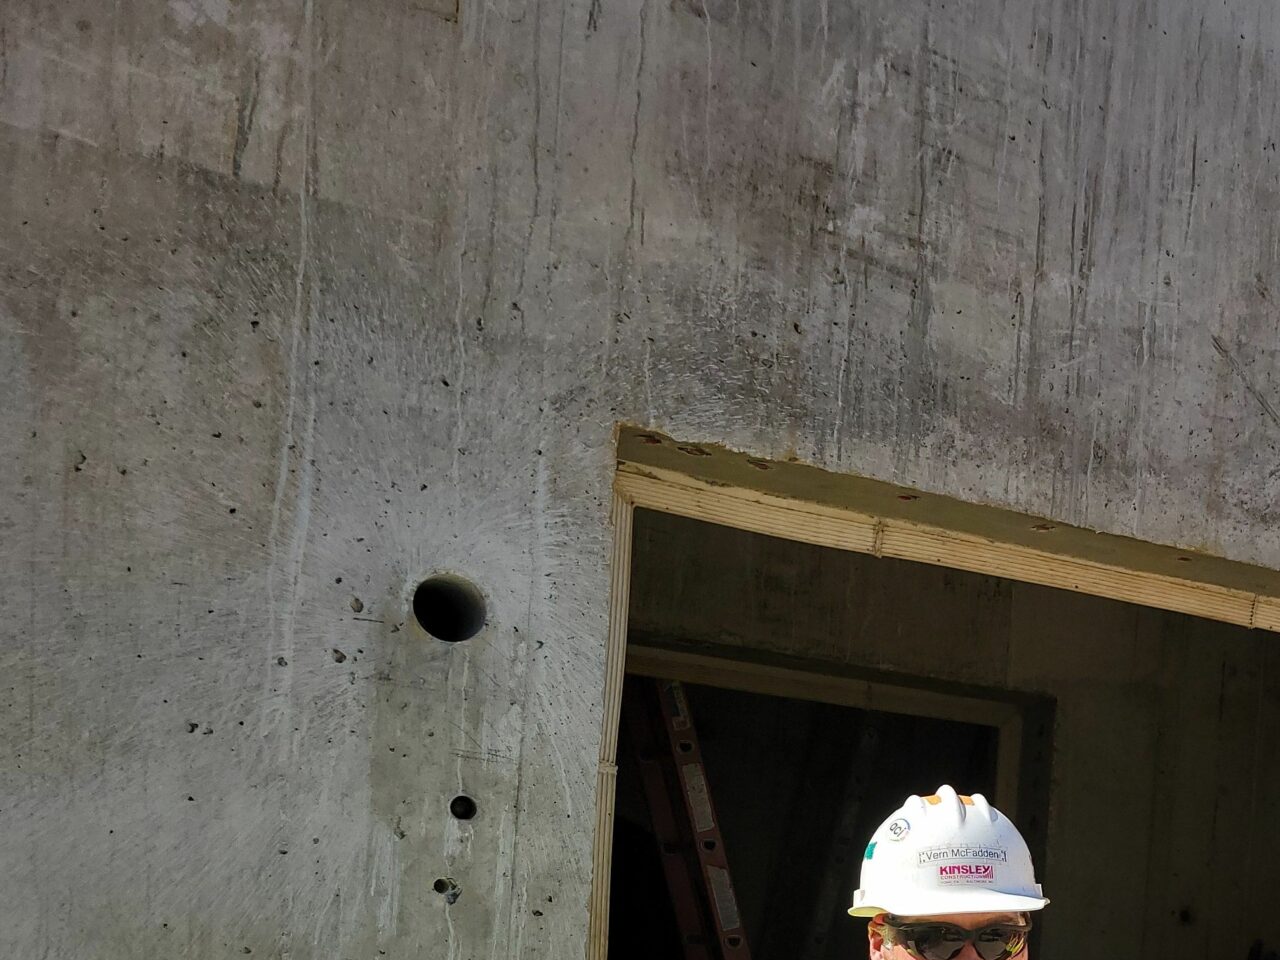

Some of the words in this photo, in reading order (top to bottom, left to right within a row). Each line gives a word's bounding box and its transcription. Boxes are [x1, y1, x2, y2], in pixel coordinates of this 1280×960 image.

[926, 850, 948, 860] Vern
[952, 848, 999, 859] McFadden
[940, 865, 990, 875] KINSLEY
